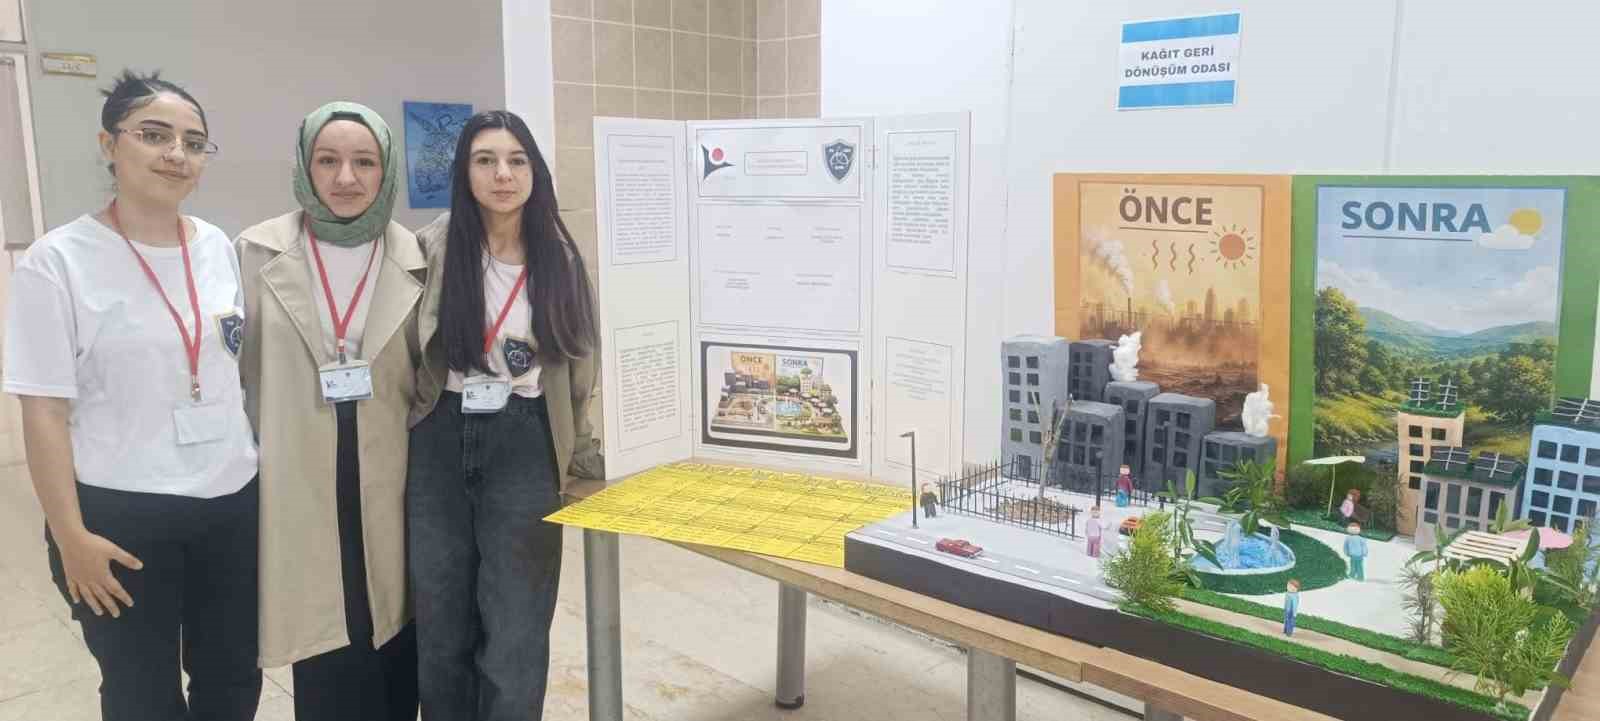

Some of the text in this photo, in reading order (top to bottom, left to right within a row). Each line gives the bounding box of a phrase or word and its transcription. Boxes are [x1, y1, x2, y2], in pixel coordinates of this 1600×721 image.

[1141, 44, 1214, 61] KAĞIT GERİ
[1125, 62, 1231, 78] DÖNÜŞÜM ODASI
[1119, 188, 1213, 226] ÖNCE
[1341, 200, 1492, 234] SONRA
